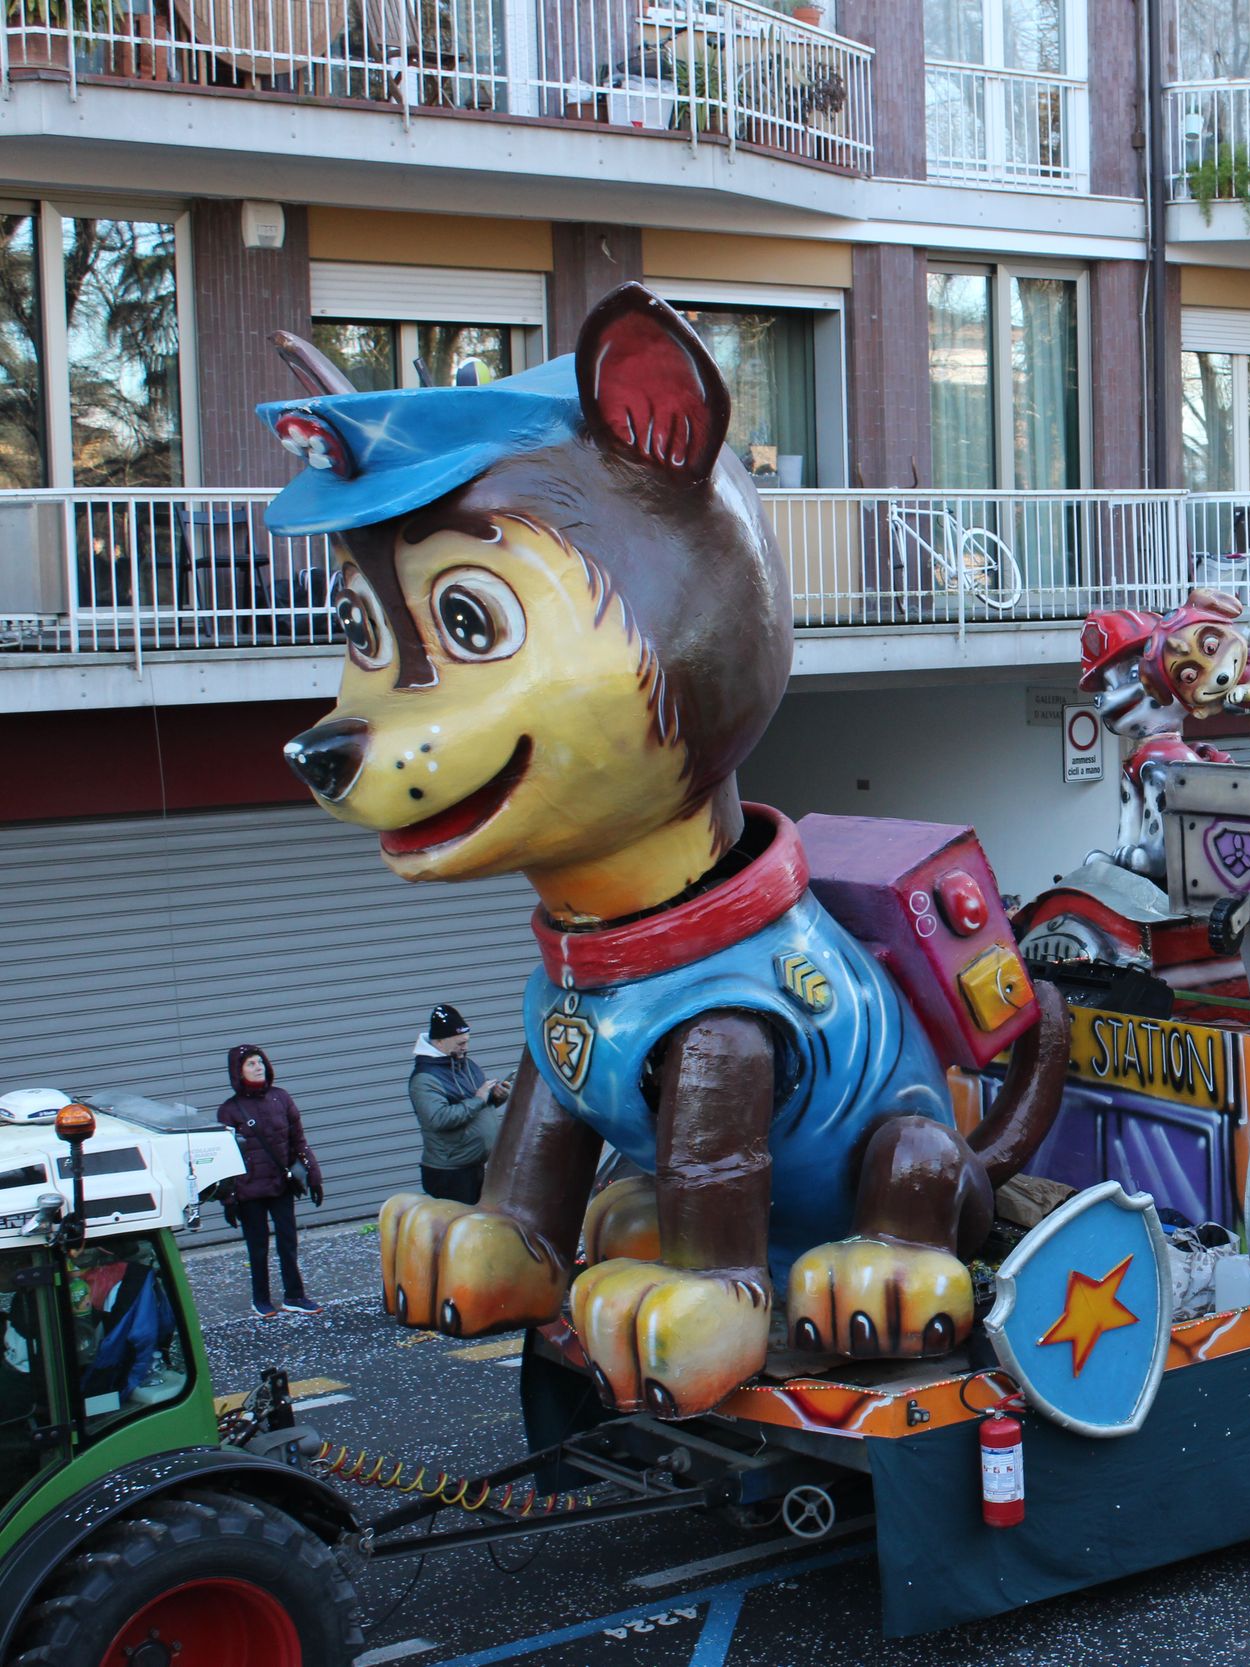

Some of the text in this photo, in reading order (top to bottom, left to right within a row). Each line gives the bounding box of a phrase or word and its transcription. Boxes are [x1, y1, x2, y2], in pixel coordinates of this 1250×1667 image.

[1035, 695, 1067, 705] GALLERIA
[1034, 710, 1062, 719] D'ALVIA
[1072, 755, 1096, 764] ammessi
[1068, 767, 1079, 776] cicli
[1090, 1016, 1217, 1098] STATION
